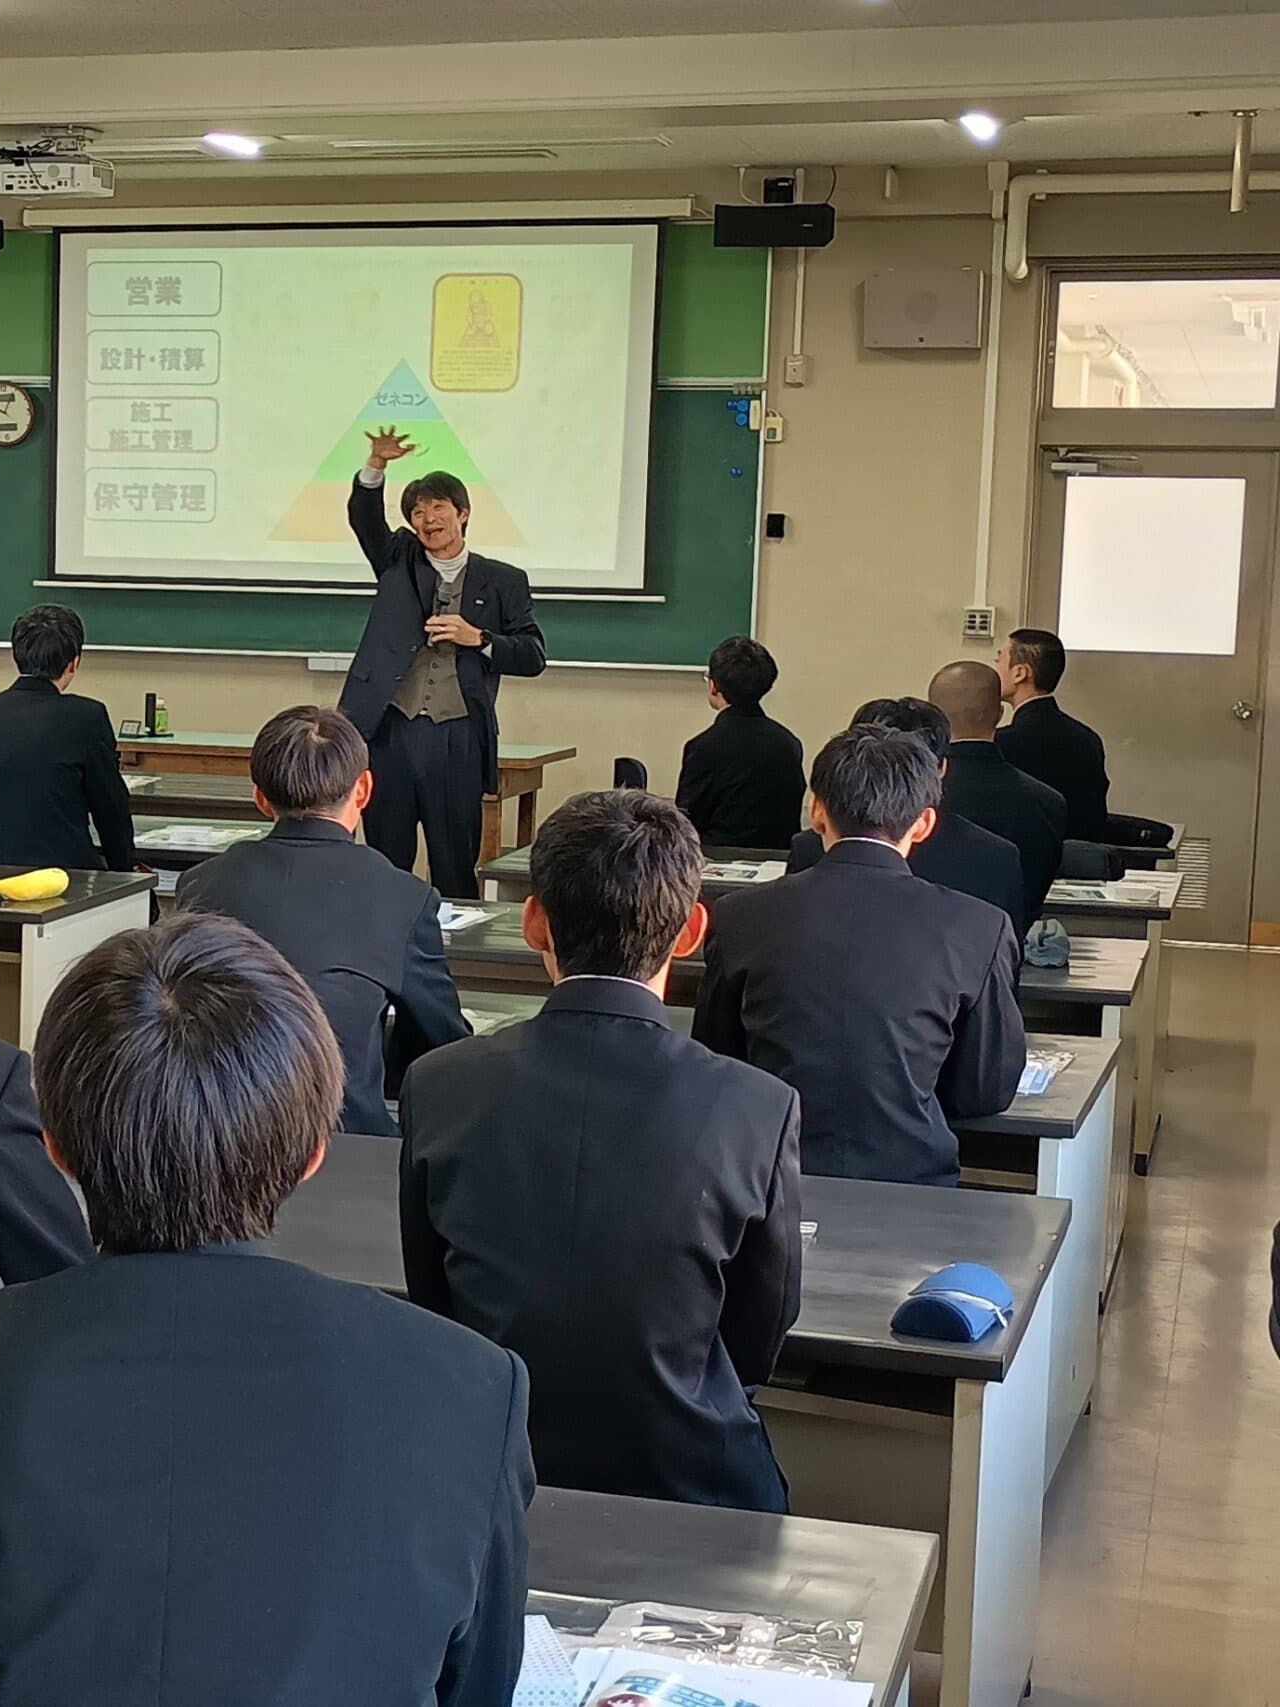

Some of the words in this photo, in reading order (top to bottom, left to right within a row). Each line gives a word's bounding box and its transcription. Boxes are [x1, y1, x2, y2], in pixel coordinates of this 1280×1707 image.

[125, 276, 182, 306] 営業
[100, 347, 206, 371] 設計・積算
[375, 392, 429, 407] ゼネコン
[130, 401, 173, 423] 施工
[110, 429, 193, 450] 施工管理
[94, 482, 207, 512] 保守管理
